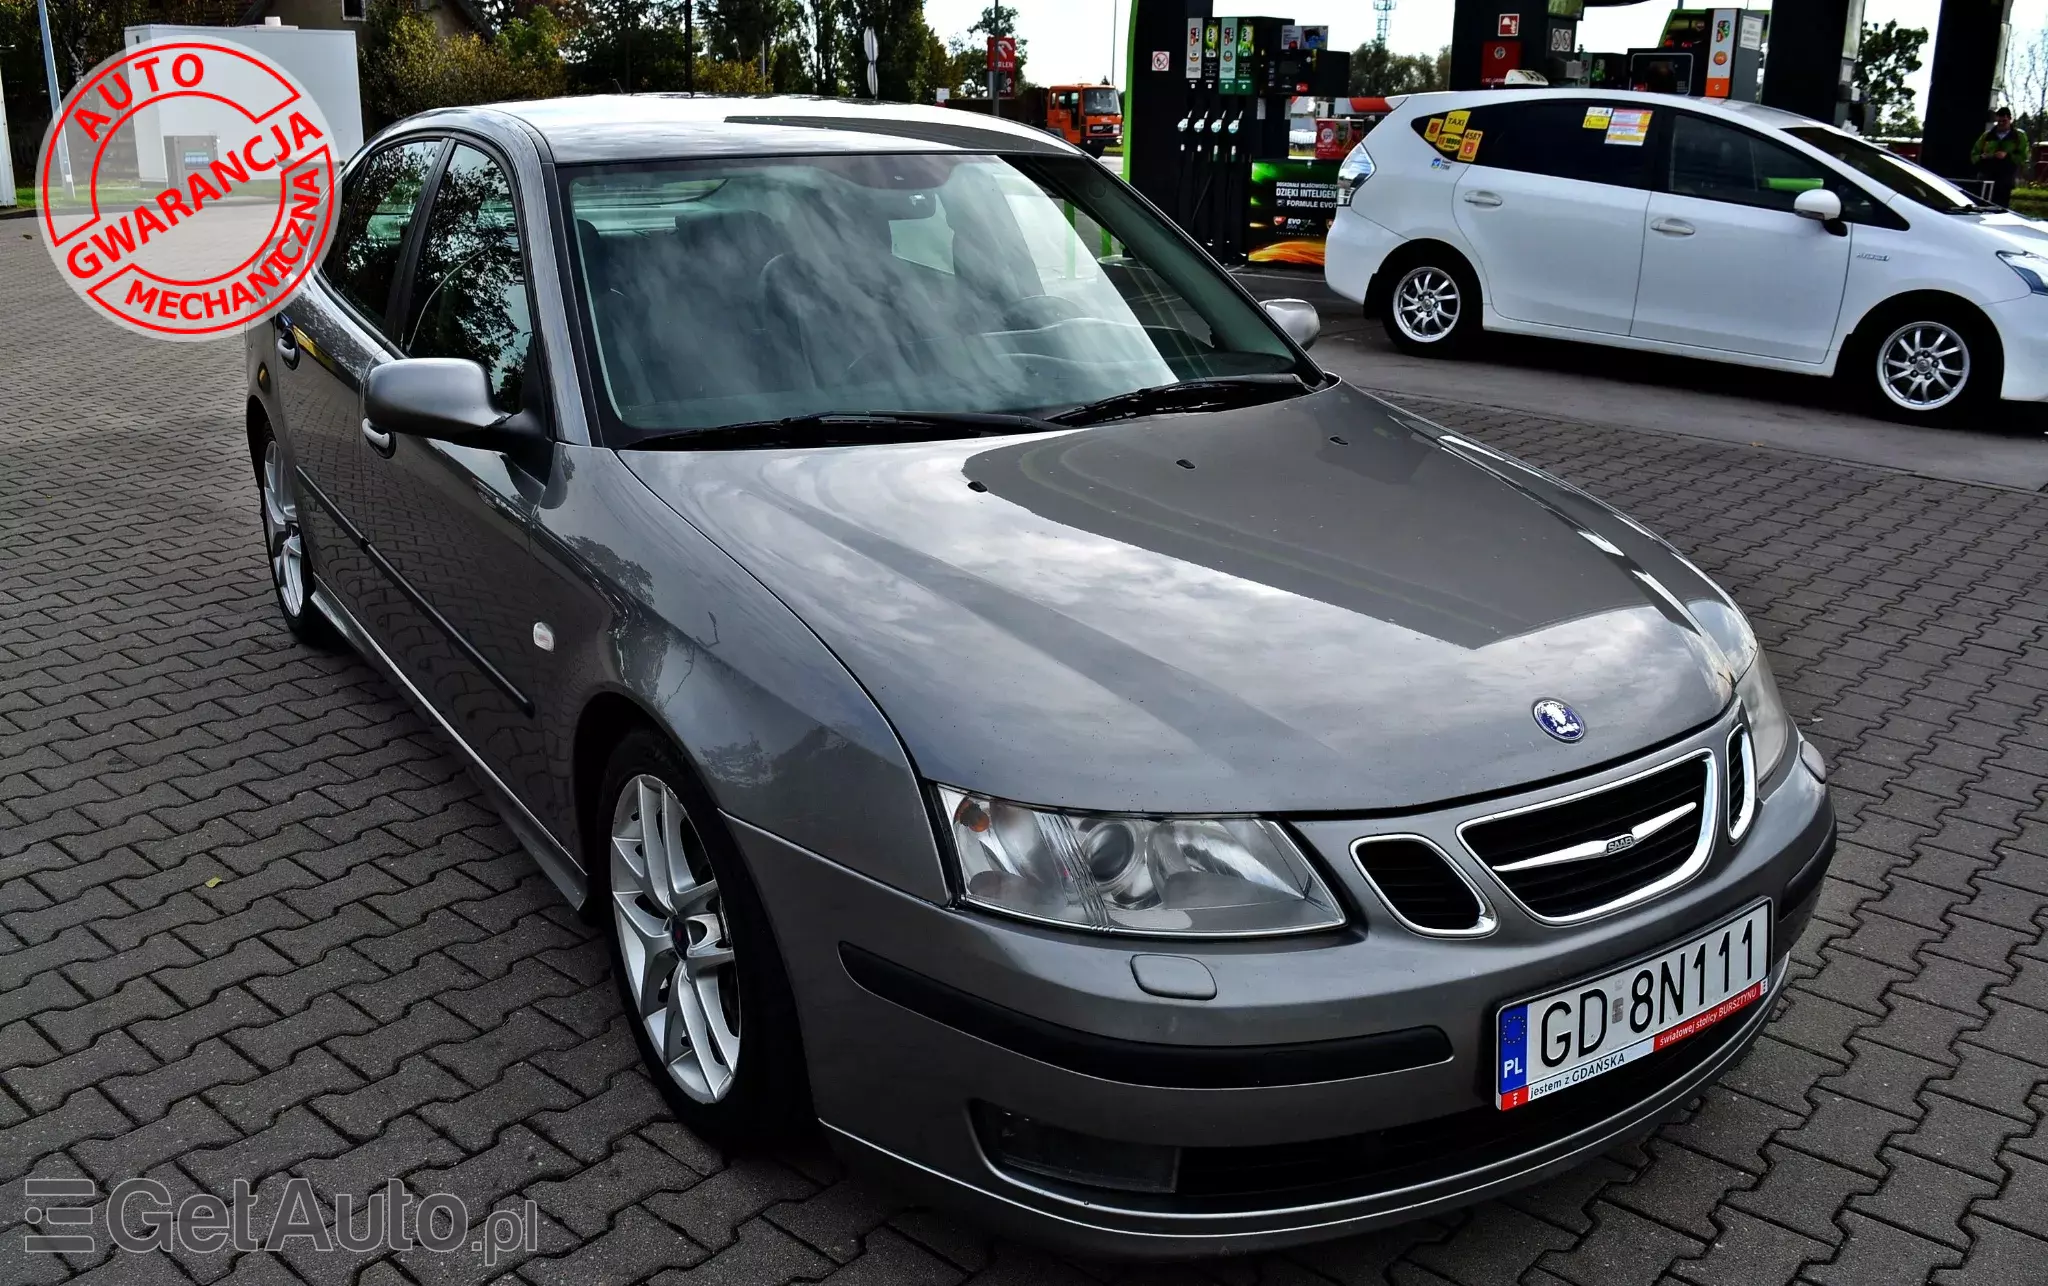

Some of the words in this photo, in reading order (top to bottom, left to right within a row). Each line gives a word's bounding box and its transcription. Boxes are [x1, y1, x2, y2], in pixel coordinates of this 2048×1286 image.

[1447, 117, 1466, 126] TAXI
[1276, 188, 1299, 199] DZIĘKI
[1286, 200, 1319, 208] FORMULE
[1608, 836, 1633, 852] SAAB
[1540, 987, 1608, 1068] GD
[1629, 919, 1753, 1034] 8N111
[1660, 1024, 1695, 1046] światowej
[1696, 1012, 1718, 1030] stolicy
[1718, 987, 1757, 1017] BURSZTYNU
[1503, 1057, 1523, 1079] PL
[1530, 1079, 1562, 1099] jestem
[1572, 1052, 1626, 1082] GDAŃSKA
